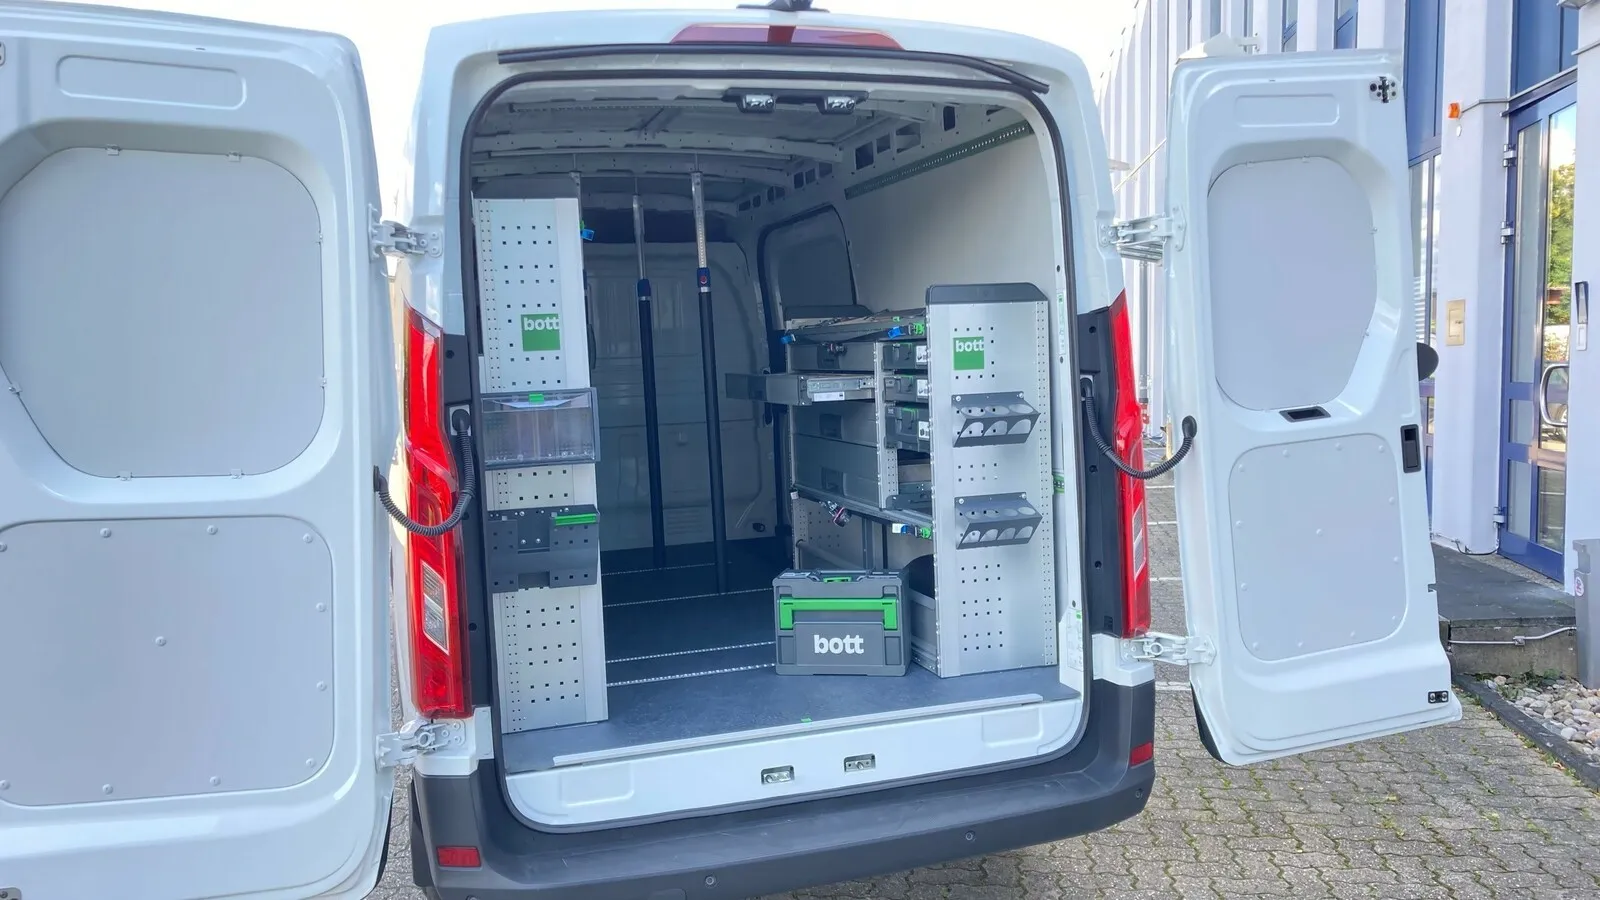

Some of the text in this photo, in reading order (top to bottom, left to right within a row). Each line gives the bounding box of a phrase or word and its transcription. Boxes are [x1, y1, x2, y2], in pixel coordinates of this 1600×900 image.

[523, 316, 561, 331] bott
[955, 339, 985, 353] bott
[813, 634, 865, 654] bott
